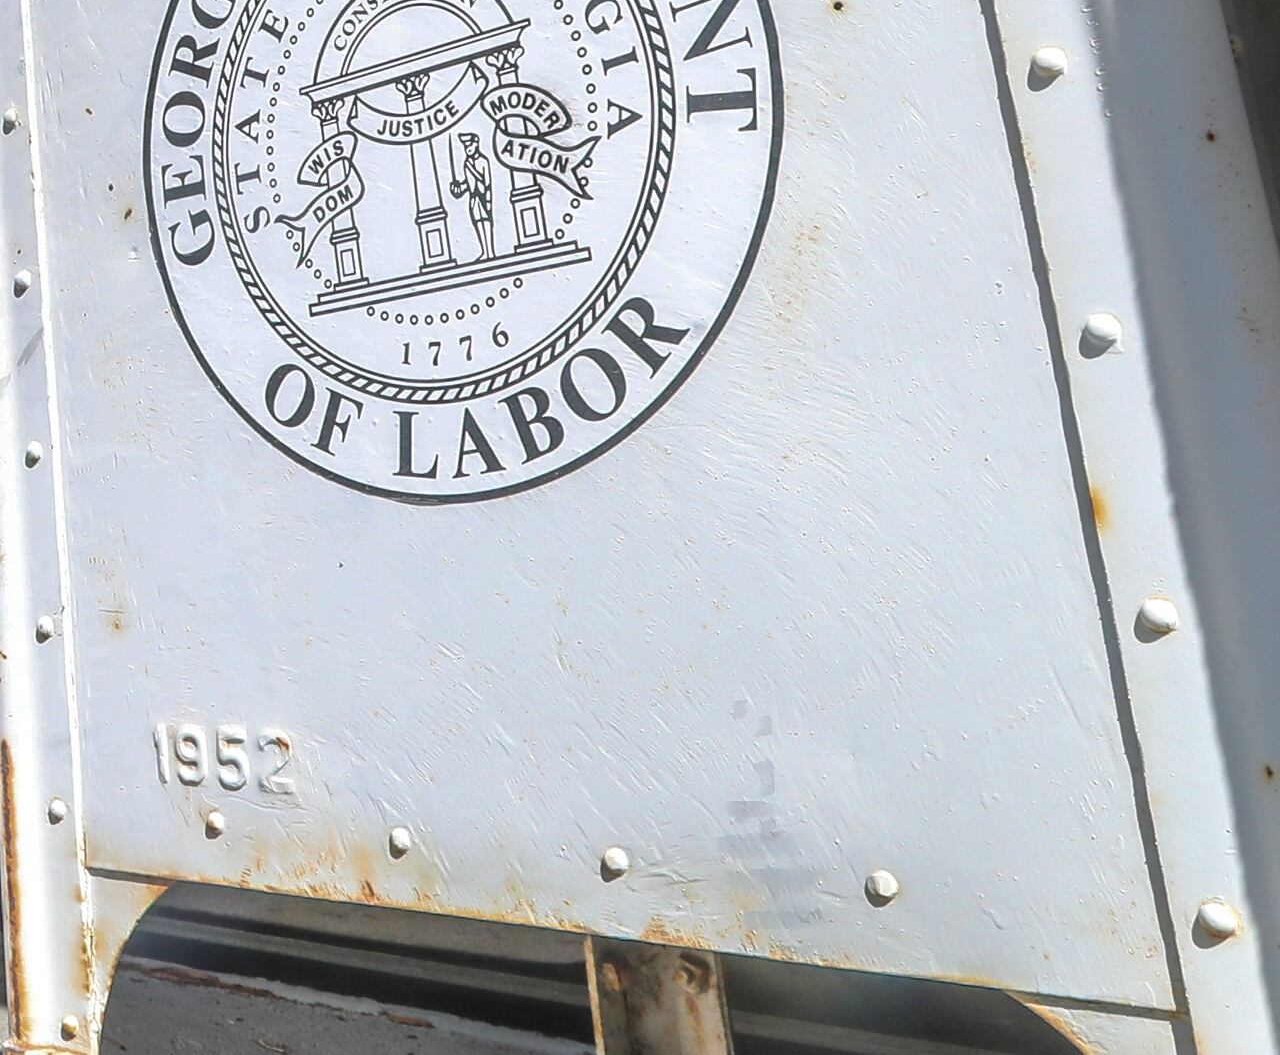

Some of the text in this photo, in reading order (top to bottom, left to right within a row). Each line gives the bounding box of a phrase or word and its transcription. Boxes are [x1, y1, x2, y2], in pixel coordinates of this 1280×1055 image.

[234, 8, 290, 233] STATE
[376, 99, 461, 138] JUSTICE
[401, 320, 510, 367] 1776
[262, 295, 692, 480] OF LABOR
[153, 721, 295, 795] 1952
